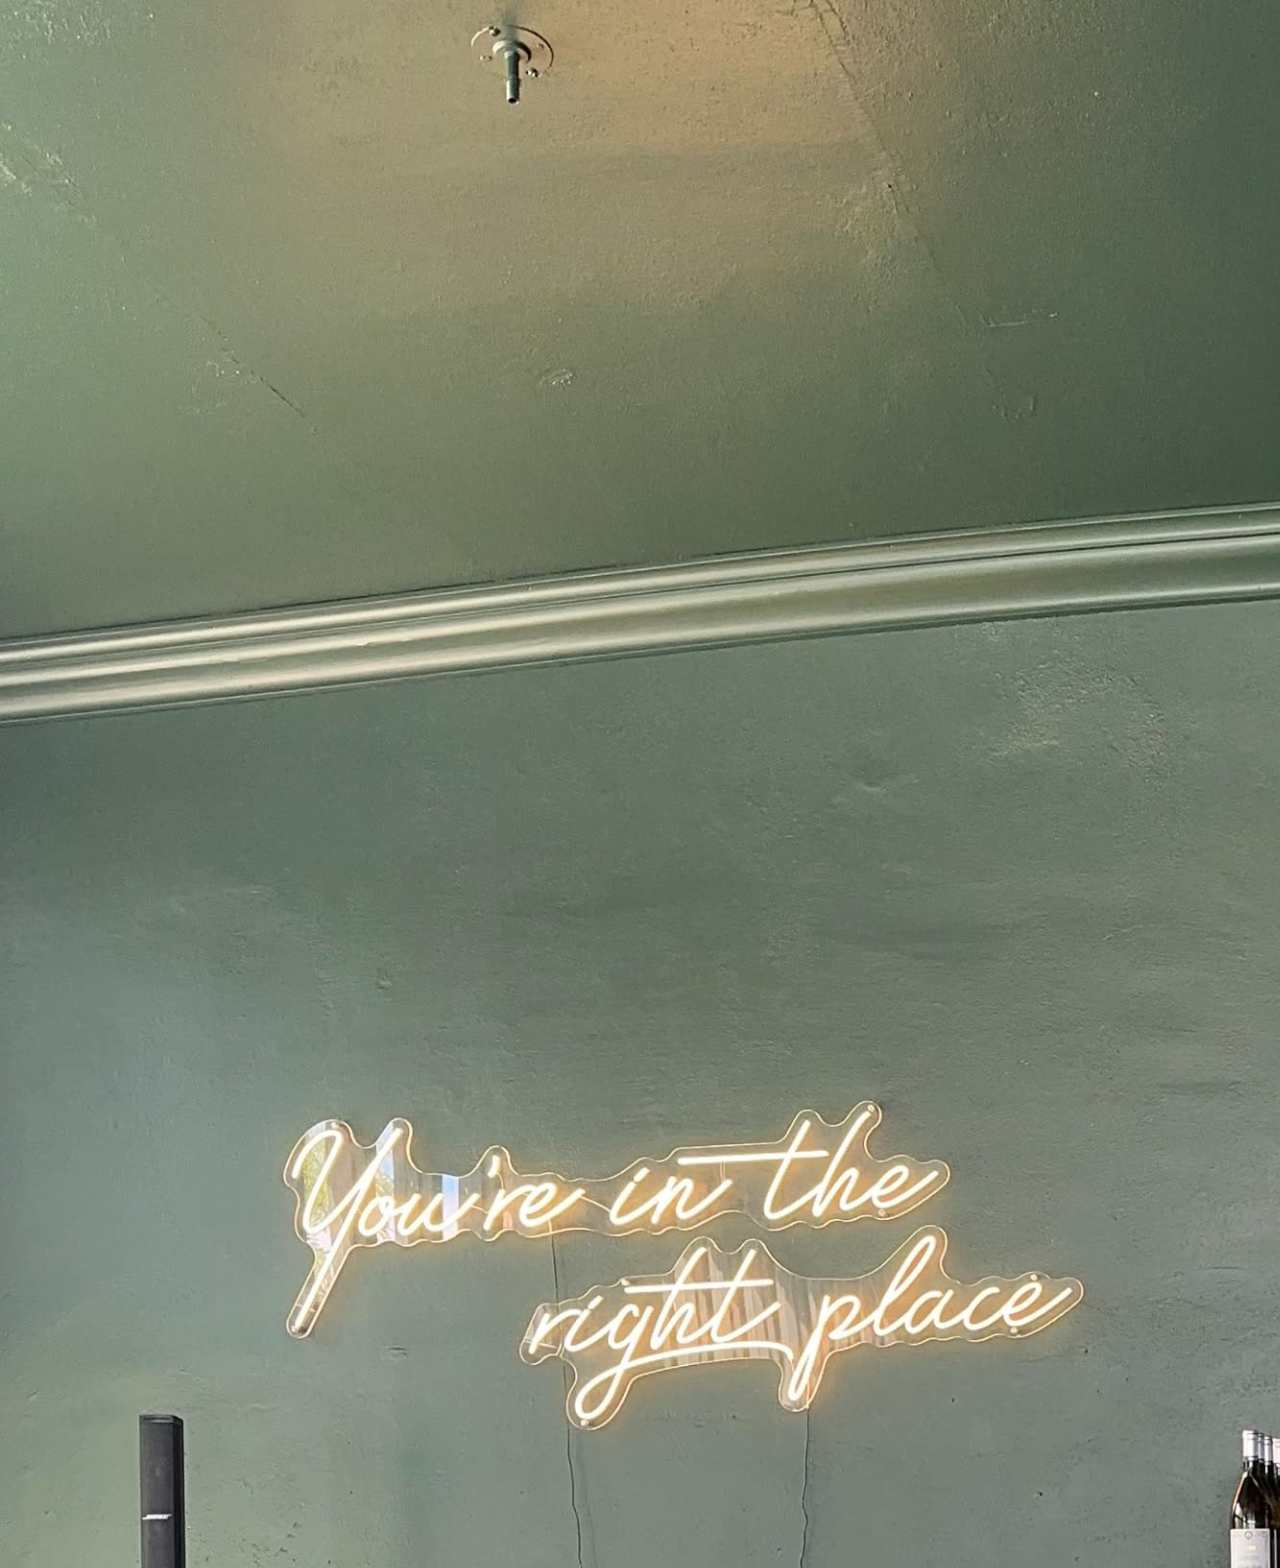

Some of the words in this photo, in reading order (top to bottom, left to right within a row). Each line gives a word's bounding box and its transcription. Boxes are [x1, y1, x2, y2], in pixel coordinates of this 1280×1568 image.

[290, 1120, 582, 1332] You're
[609, 1166, 732, 1228] in
[677, 1105, 939, 1222] the
[529, 1246, 796, 1424] right
[788, 1234, 1073, 1403] place
